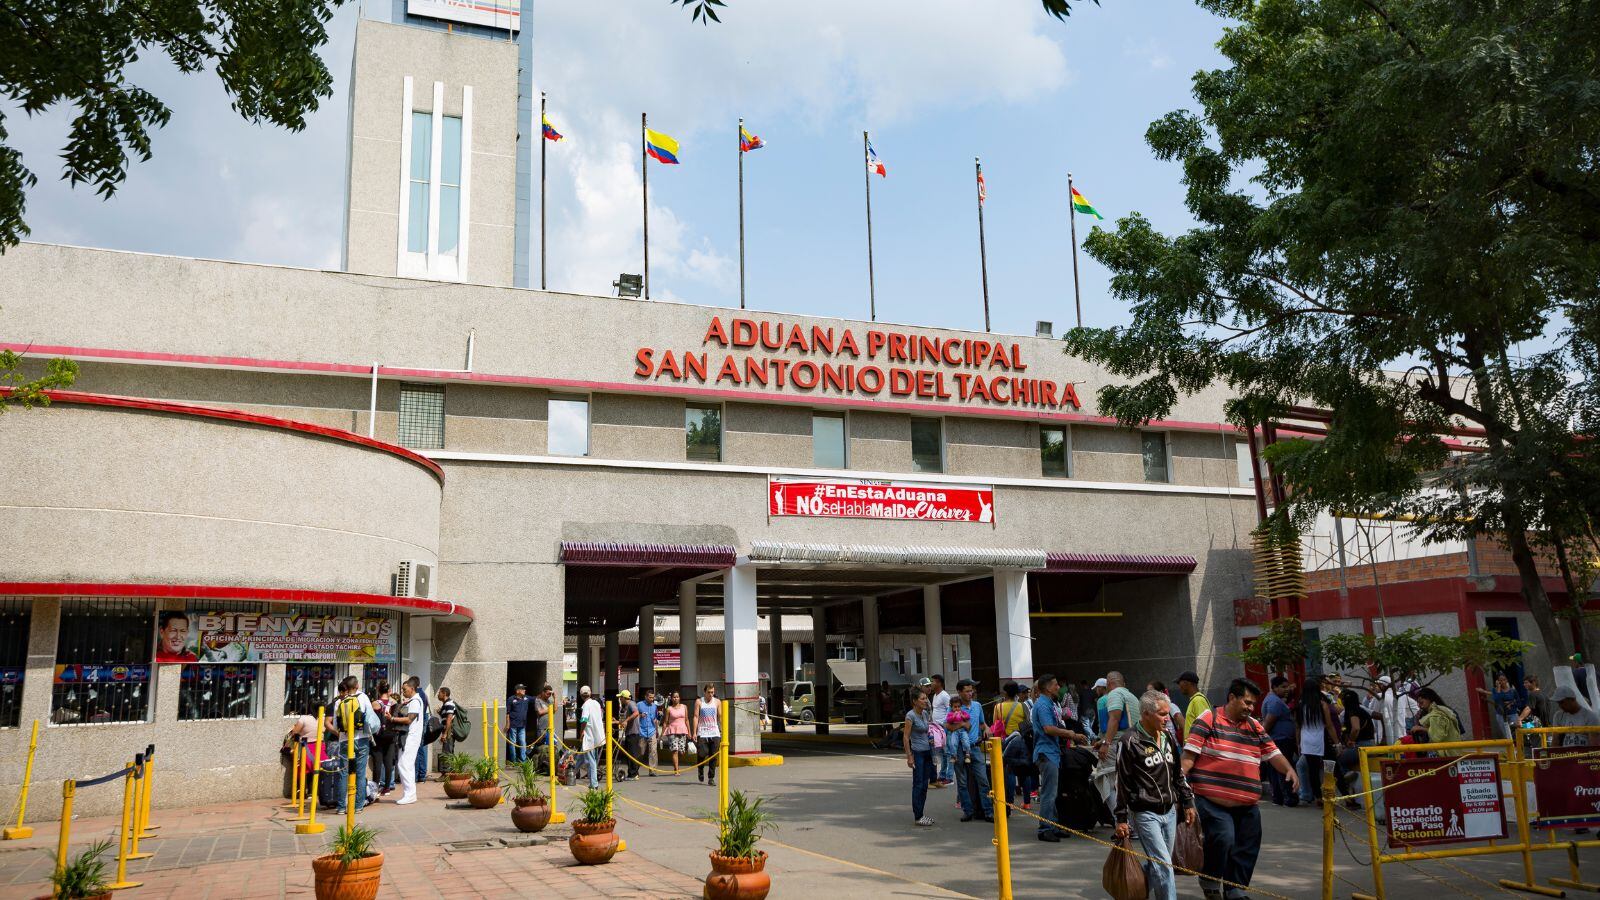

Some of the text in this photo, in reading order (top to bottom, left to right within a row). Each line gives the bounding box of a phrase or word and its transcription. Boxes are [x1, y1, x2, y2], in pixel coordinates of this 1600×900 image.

[703, 316, 1028, 369] ADUANA PRINCIPAL
[635, 347, 1081, 408] SAN ANTONIO DEL TACHIRA
[813, 485, 947, 502] #EnEstaAduana
[199, 615, 392, 636] BIENVENIDOS
[303, 652, 337, 660] PASAPORTE
[86, 669, 99, 682] 4
[204, 667, 212, 681] 3
[296, 669, 304, 680] 2
[1466, 787, 1491, 795] Sábado
[1390, 805, 1443, 816] Horario
[1391, 815, 1444, 824] Establecido
[1391, 822, 1444, 831] Para Paso
[1392, 828, 1445, 840] Peatonal
